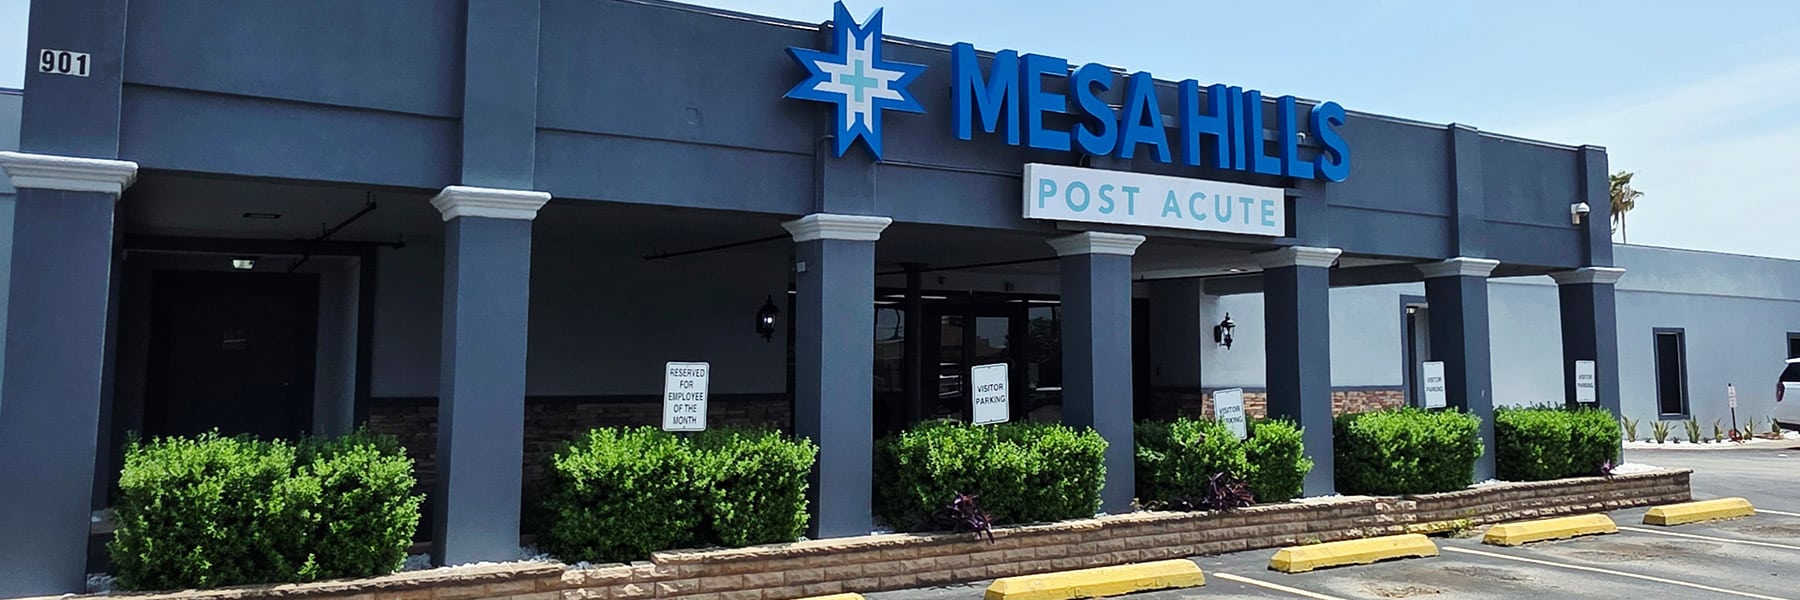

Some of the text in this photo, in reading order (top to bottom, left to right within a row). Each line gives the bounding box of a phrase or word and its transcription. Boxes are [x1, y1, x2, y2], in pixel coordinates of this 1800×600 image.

[42, 50, 86, 75] 901
[951, 42, 1350, 183] MESA HILLS
[1038, 178, 1276, 227] POST ACUTE
[670, 368, 705, 377] RESERVED
[680, 380, 694, 389] FOR
[977, 383, 1004, 393] VISITOR
[668, 392, 704, 401] EMPLOYEE
[976, 395, 1006, 405] PARKING
[673, 404, 697, 413] OF THE
[1219, 405, 1241, 414] VISITOR
[673, 416, 697, 424] MONTH
